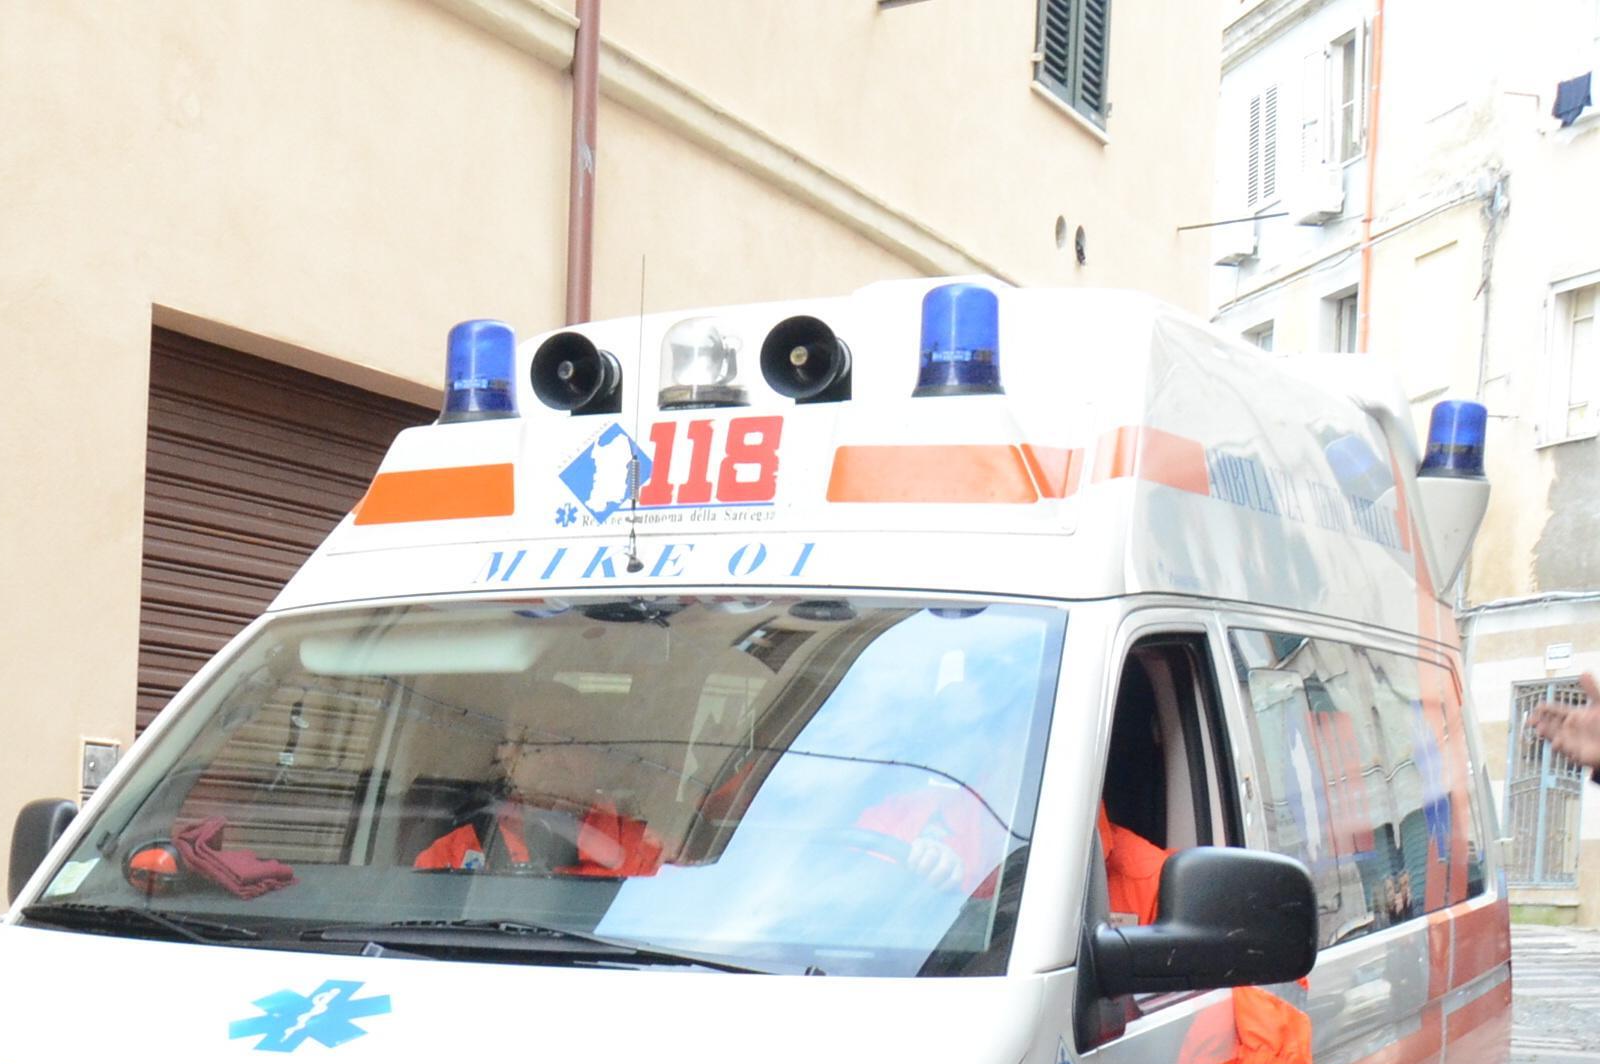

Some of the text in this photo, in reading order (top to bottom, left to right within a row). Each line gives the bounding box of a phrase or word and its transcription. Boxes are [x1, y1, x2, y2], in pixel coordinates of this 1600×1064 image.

[638, 414, 785, 506] 118
[630, 510, 683, 524] utonoma
[690, 506, 717, 522] della
[472, 543, 695, 584] MIKE
